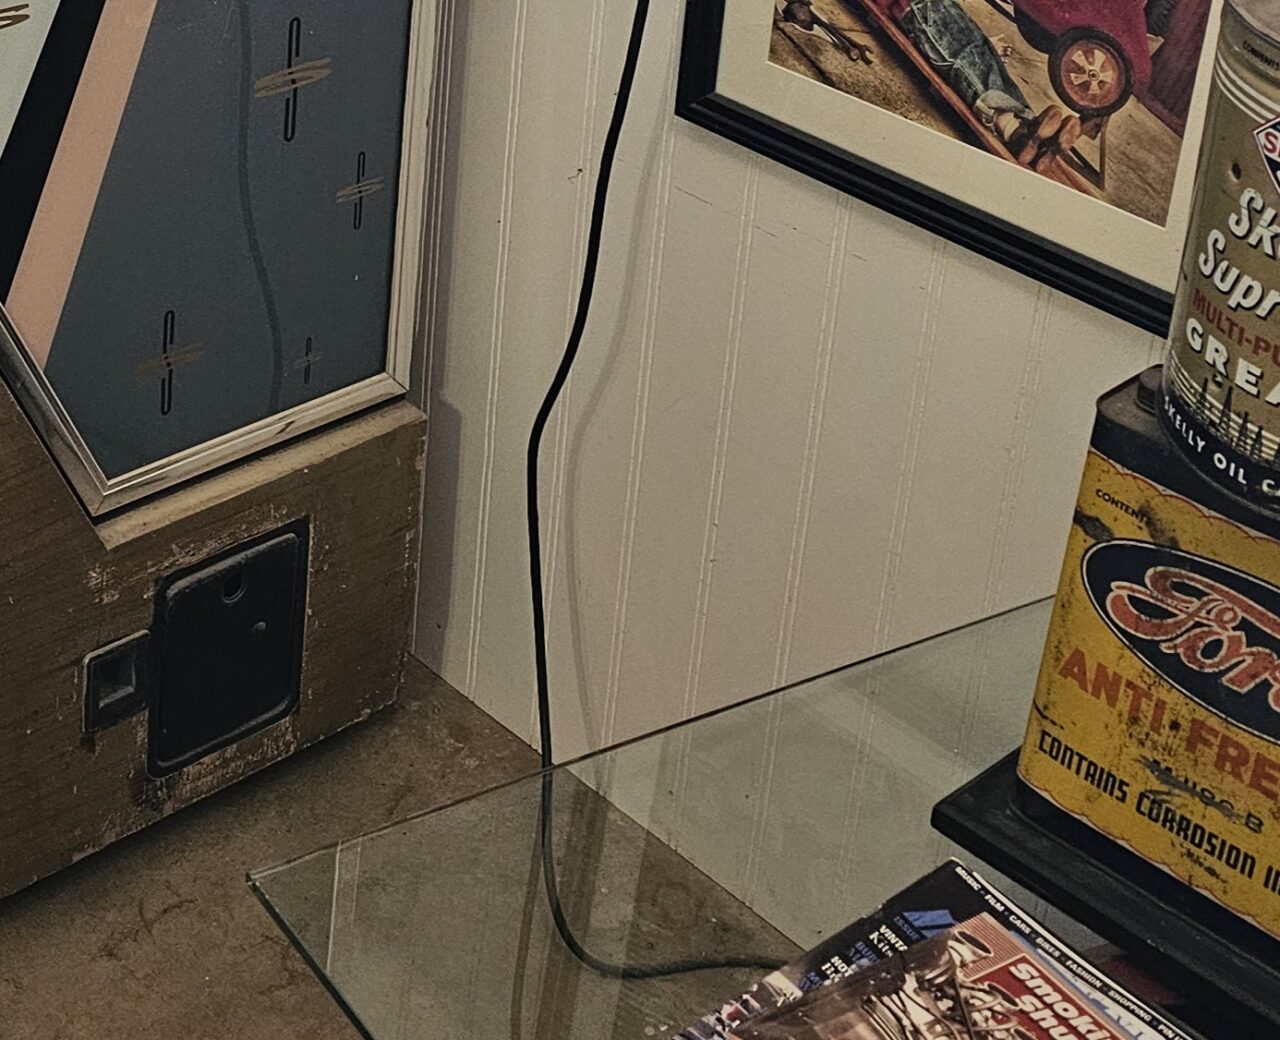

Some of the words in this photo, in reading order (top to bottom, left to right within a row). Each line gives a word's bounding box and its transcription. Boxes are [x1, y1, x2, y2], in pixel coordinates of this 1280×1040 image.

[1164, 395, 1206, 453] SKELLY
[1213, 452, 1247, 485] OIL
[1038, 728, 1130, 805] CONTAINS
[1135, 790, 1257, 880] CORROSION
[955, 866, 981, 891] MUSIC
[984, 894, 1005, 913] FILM
[1009, 915, 1031, 935] CARS
[1035, 936, 1061, 958] BIKES
[1066, 960, 1103, 989] FASHION
[1108, 989, 1152, 1021] SHOPPING
